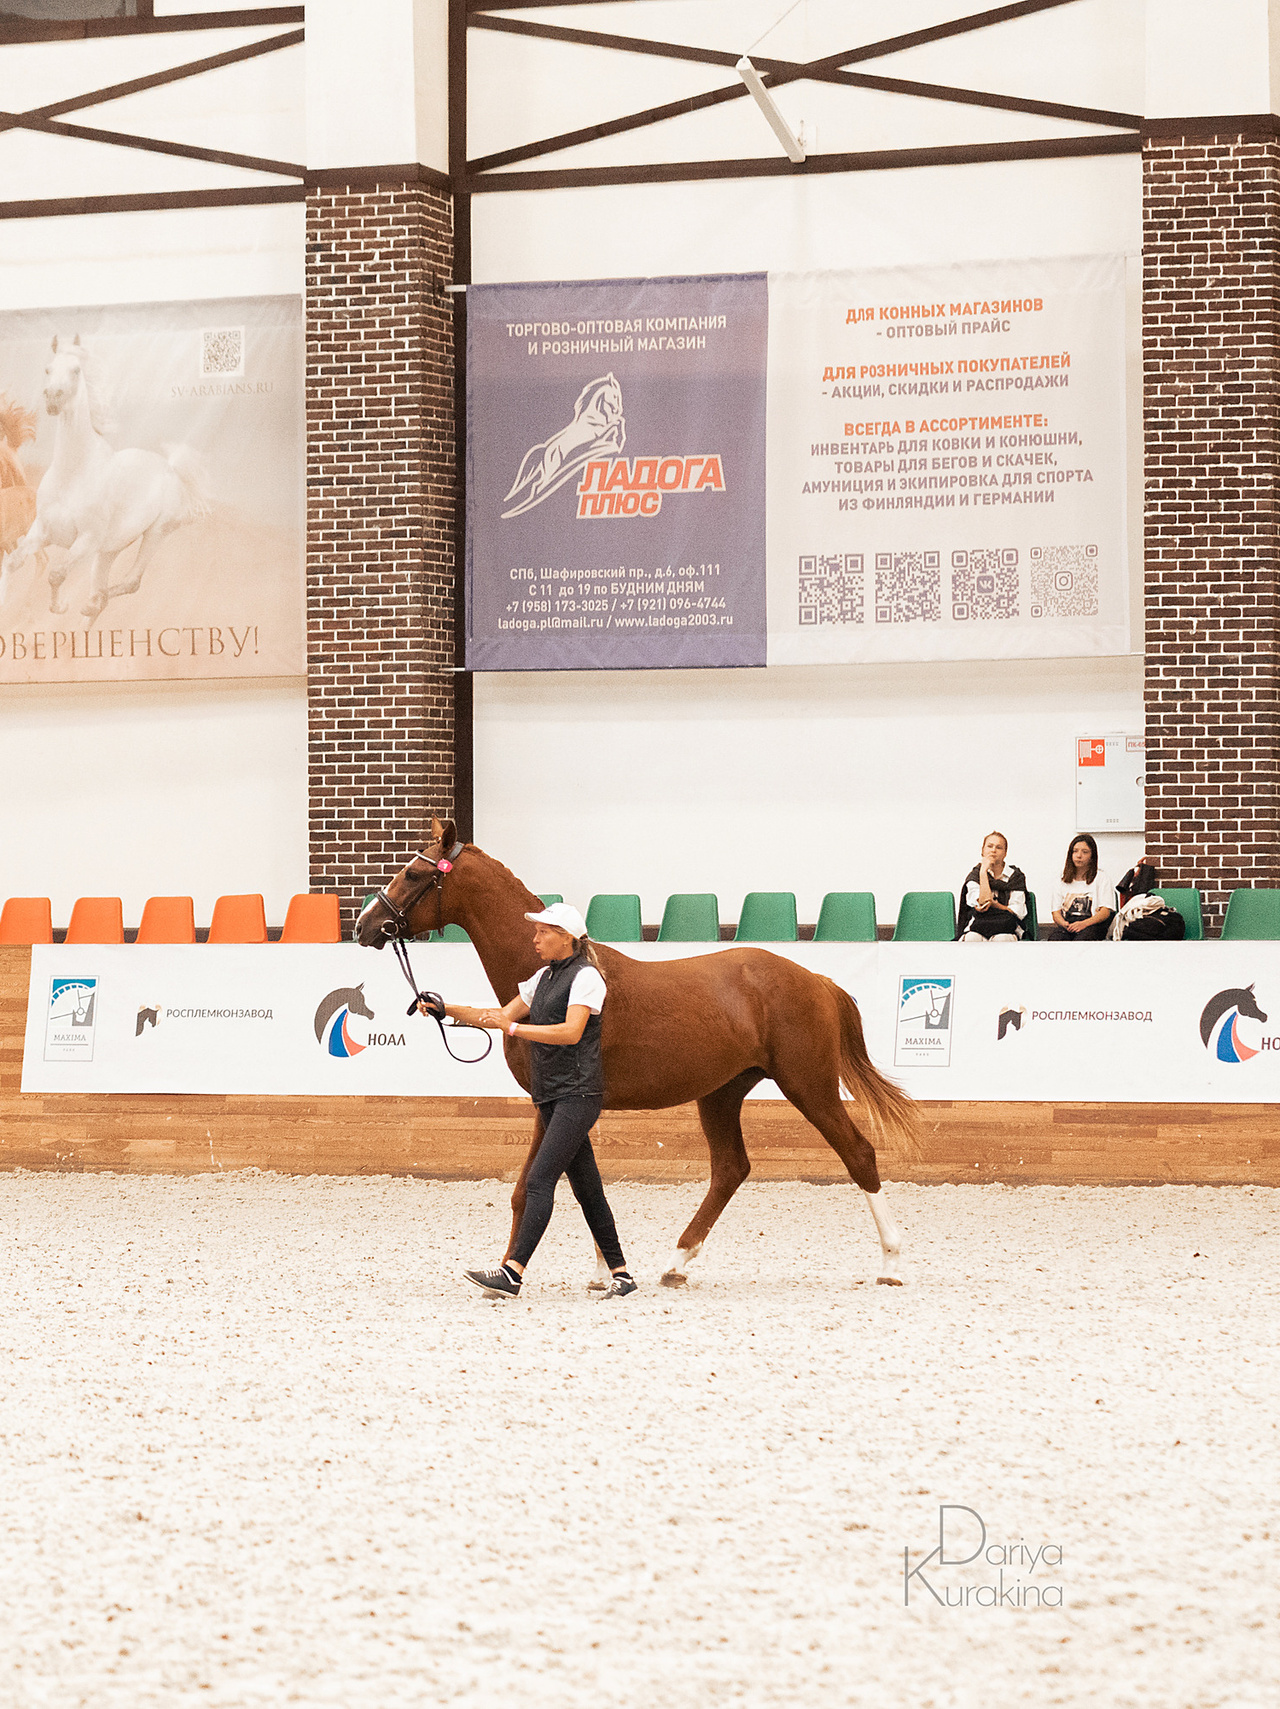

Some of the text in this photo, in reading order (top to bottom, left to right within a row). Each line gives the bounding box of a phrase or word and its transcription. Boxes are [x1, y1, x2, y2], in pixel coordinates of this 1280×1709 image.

[846, 298, 1043, 323] ДЛЯ КОННЫХ МАГАЗИНОВ
[506, 315, 726, 337] ТОРГОВО-ОПТОВАЯ КОМПАНИЯ
[887, 321, 957, 339] ОПТОВЫЙ
[962, 318, 1010, 335] ПРАЙС
[529, 336, 705, 355] И РОЗНИЧНЫЙ МАГАЗИН
[823, 352, 1071, 383] ДЛЯ РОЗНИЧНЫХ ПОКУПАТЕЛЕЙ
[832, 383, 885, 400] АКЦИИ,
[889, 380, 949, 396] СКИДКИ
[953, 379, 962, 392] И
[966, 374, 1069, 392] РАСПРОДАЖИ
[844, 414, 1048, 437] ВСЕГДА В АССОРТИМЕНТЕ:
[811, 431, 1083, 457] ИНВЕНТАРЬ ДЛЯ КОВКИ И КОНЮШНИ,
[835, 452, 1058, 474] ТОВАРЫ ДЛЯ БЕГОВ И СКАЧЕК,
[580, 457, 722, 492] ЛАДОГА
[802, 469, 1093, 494] АМУНИЦИЯ И ЭКИПИРОВКА ДЛЯ СПОРТА
[579, 493, 659, 517] ПЛЮС
[839, 490, 1054, 511] ИЗ ФИНЛЯНДИИ И ГЕРМАНИИ
[510, 564, 720, 581] СПб, Шафировский пр., д.6, оф.111
[529, 581, 704, 597] С 11 до 19 по БУДНИМ ДНЯМ
[506, 597, 726, 614] +7 (958) 173-3025 / +7 (921) 096-4744
[498, 613, 733, 631] ladoga.pl@mail.ru / www.ladoga2003.ru
[166, 1008, 273, 1020] РОСПЛЕМКОНЗАВОД
[1032, 1010, 1152, 1023] РОСПЛЕМКОНЗАВОД
[53, 1034, 87, 1042] MAXIMA
[368, 1033, 406, 1046] НОАЛ
[905, 1037, 942, 1045] MAXIMA
